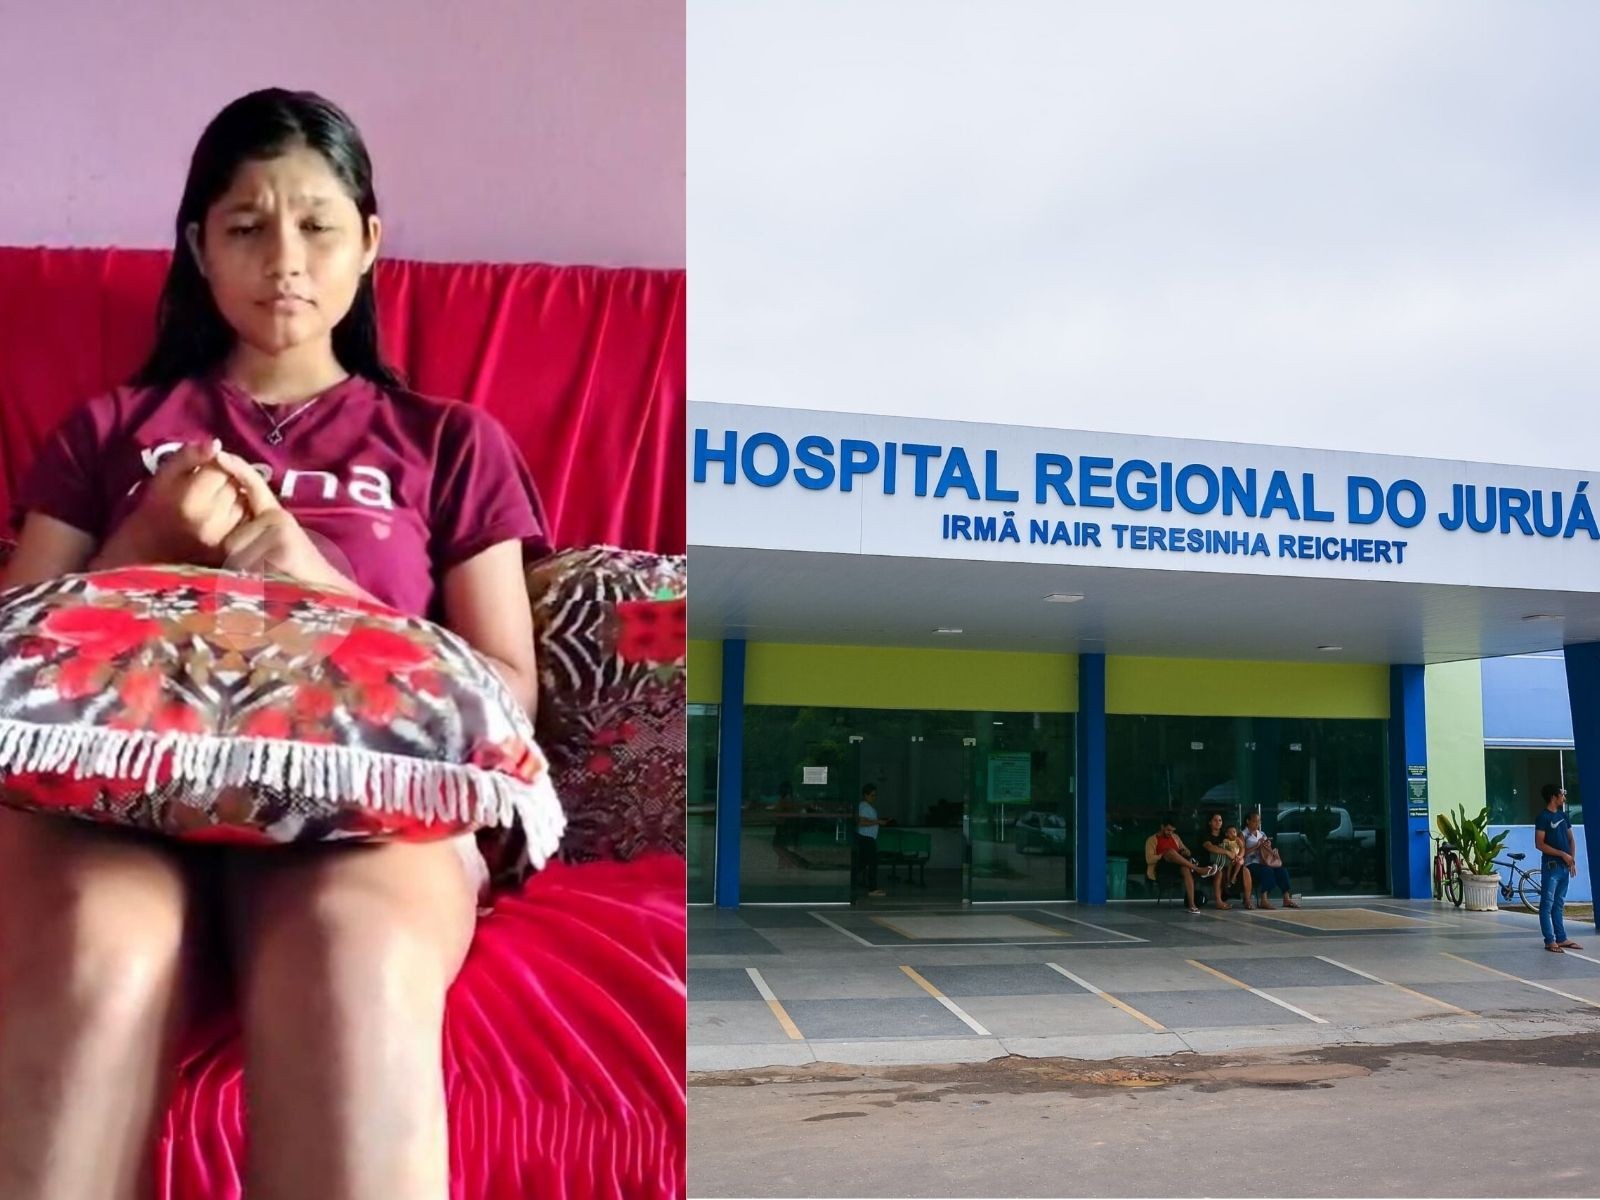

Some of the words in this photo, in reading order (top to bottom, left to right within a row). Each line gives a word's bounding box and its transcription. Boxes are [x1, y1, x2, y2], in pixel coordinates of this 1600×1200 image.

[692, 427, 1020, 503] HOSPITAL
[1034, 451, 1335, 523] REGIONAL
[1346, 474, 1427, 529] DO
[1438, 480, 1600, 541] JURUÁ
[942, 510, 1021, 543] IRMÃ
[1028, 519, 1102, 547] NAIR
[1111, 523, 1271, 557] TERESINHA
[1278, 533, 1408, 564] REICHERT
